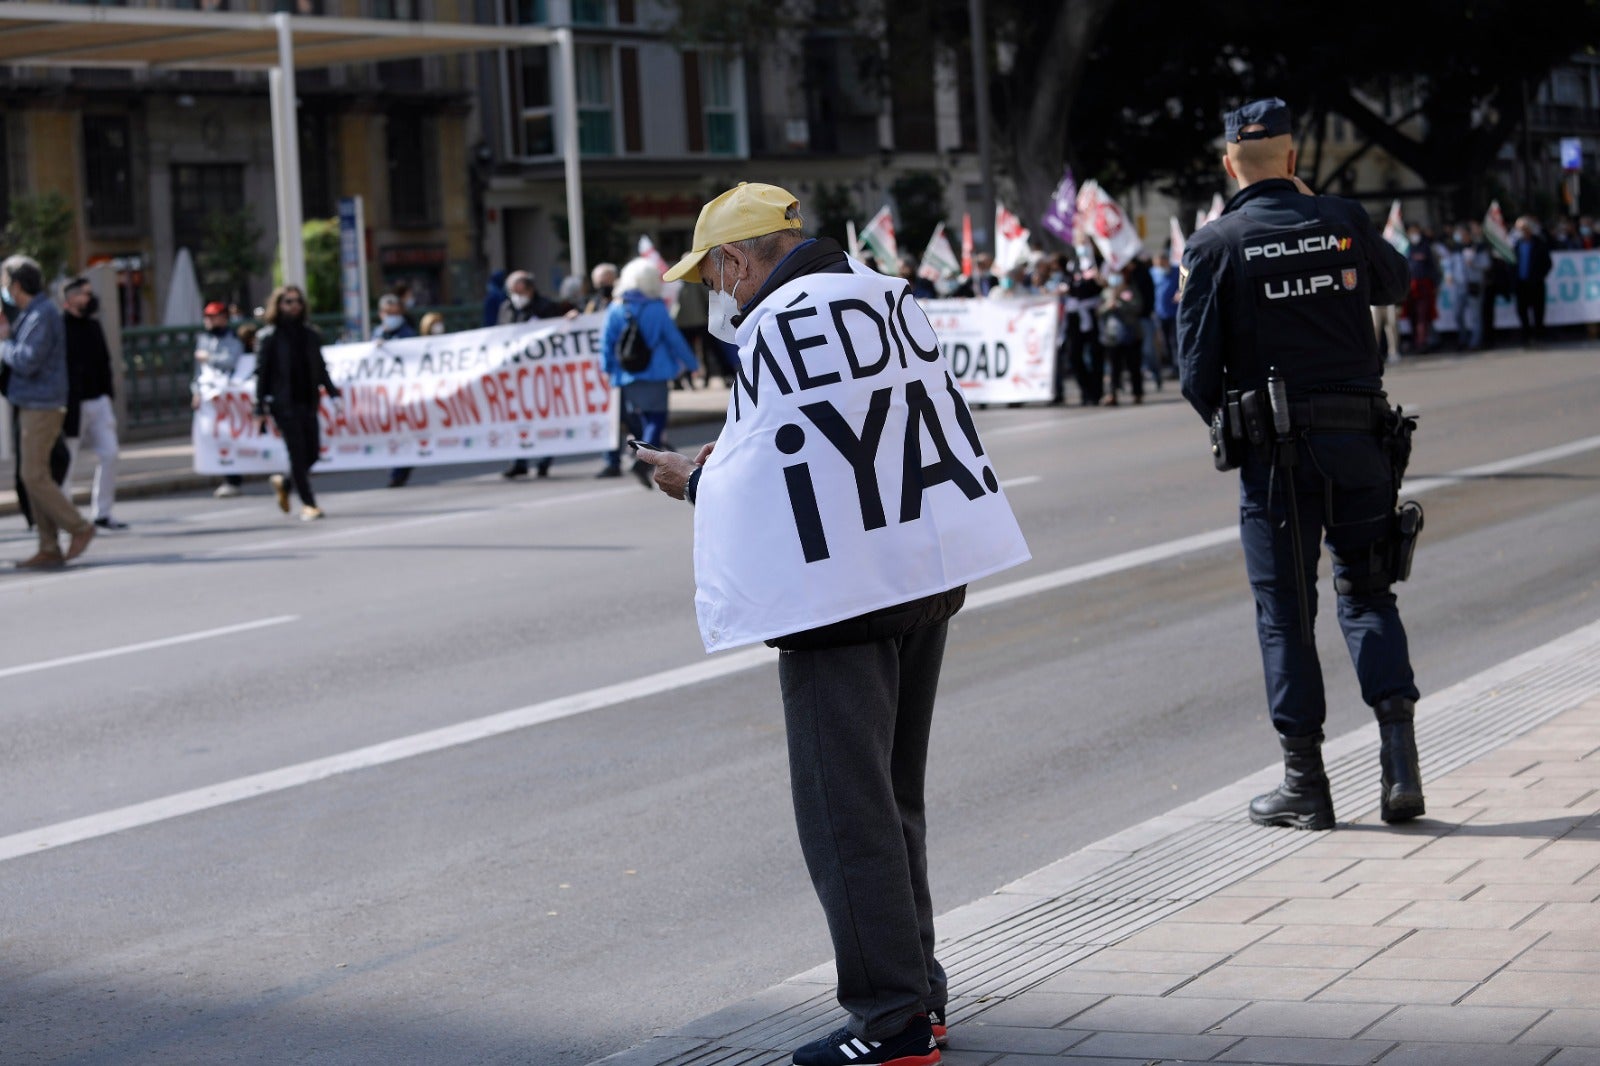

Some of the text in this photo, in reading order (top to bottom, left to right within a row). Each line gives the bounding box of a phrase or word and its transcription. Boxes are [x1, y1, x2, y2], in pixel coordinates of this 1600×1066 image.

[1245, 236, 1340, 261] POLICIA
[1265, 275, 1339, 300] U.I.P.
[501, 327, 601, 367] NORTE
[433, 378, 482, 428] SIN
[481, 360, 612, 422] RECORTES
[774, 371, 999, 563] ¡YA!
